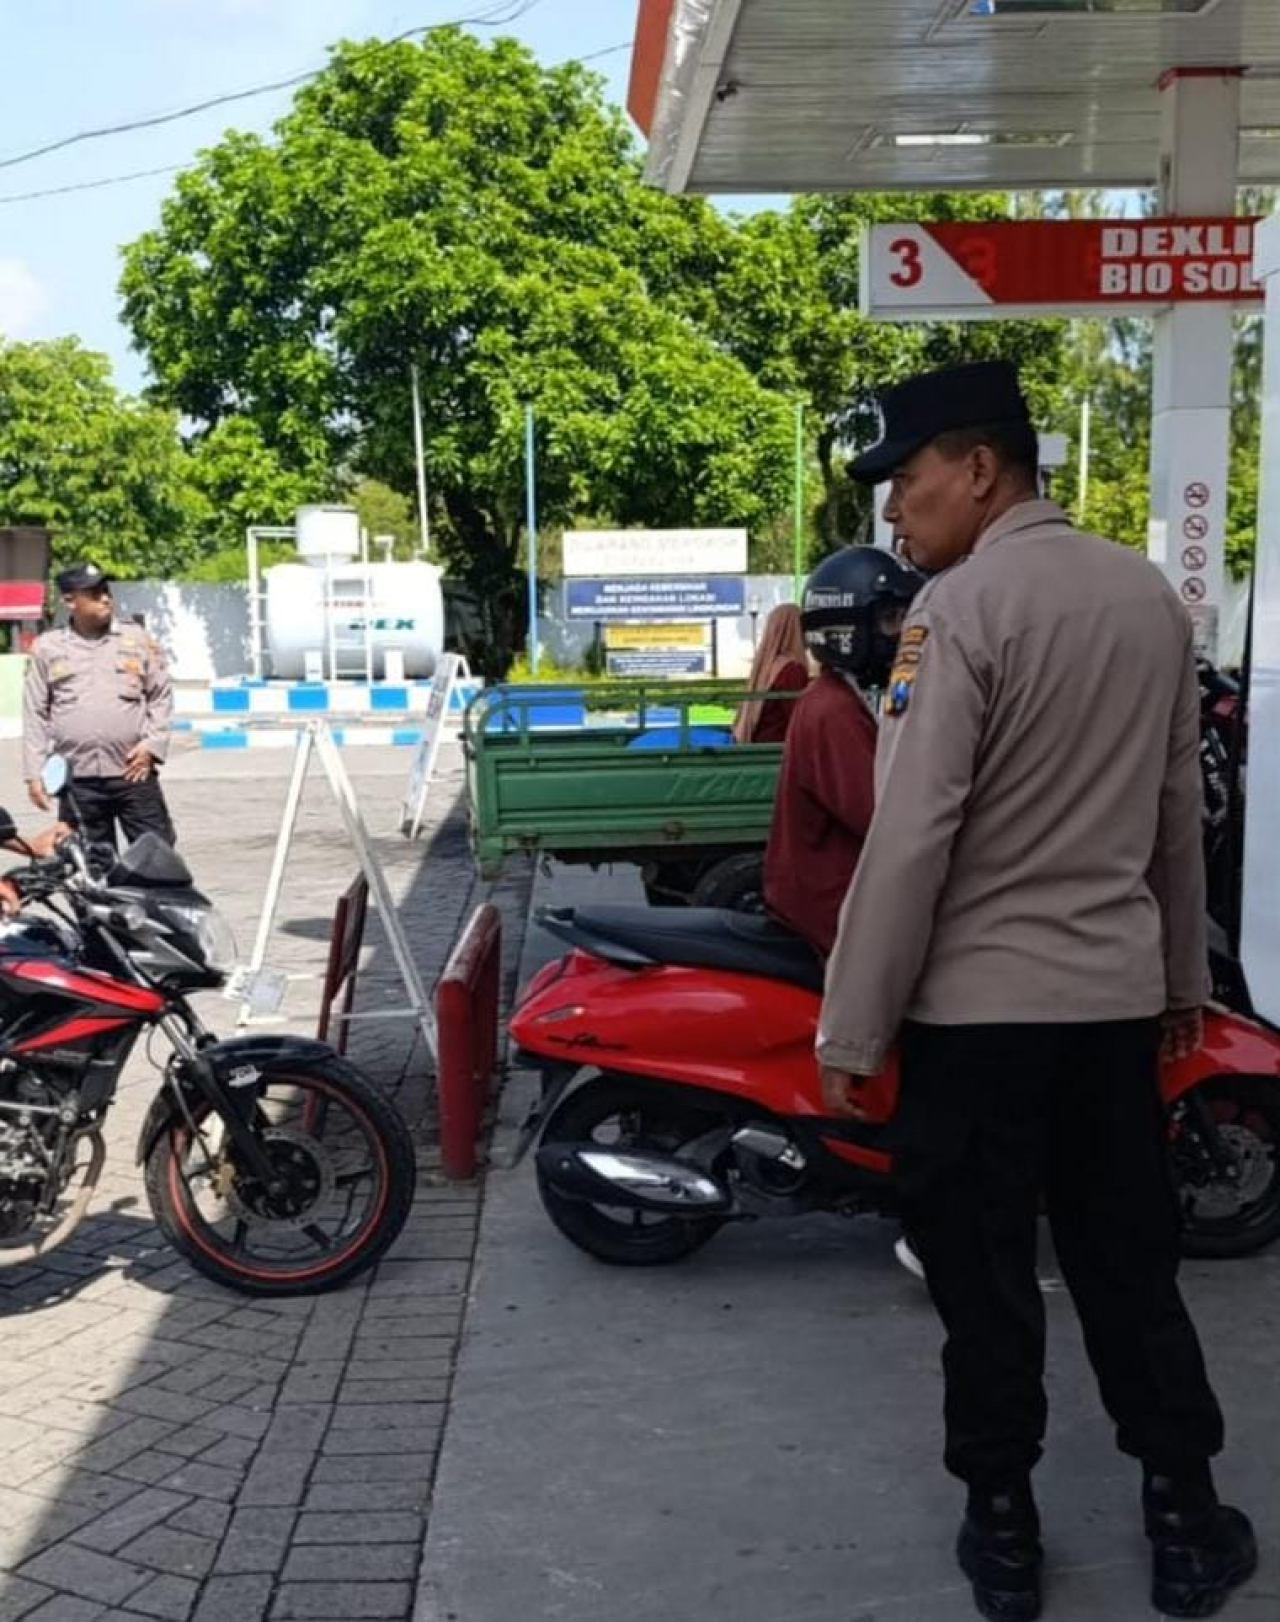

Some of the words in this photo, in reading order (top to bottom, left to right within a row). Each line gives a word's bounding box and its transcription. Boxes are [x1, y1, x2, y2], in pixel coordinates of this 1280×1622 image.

[1101, 225, 1252, 257] DEXLI
[889, 237, 923, 288] 3
[1100, 262, 1173, 294] BIO
[1182, 260, 1266, 293] SOL
